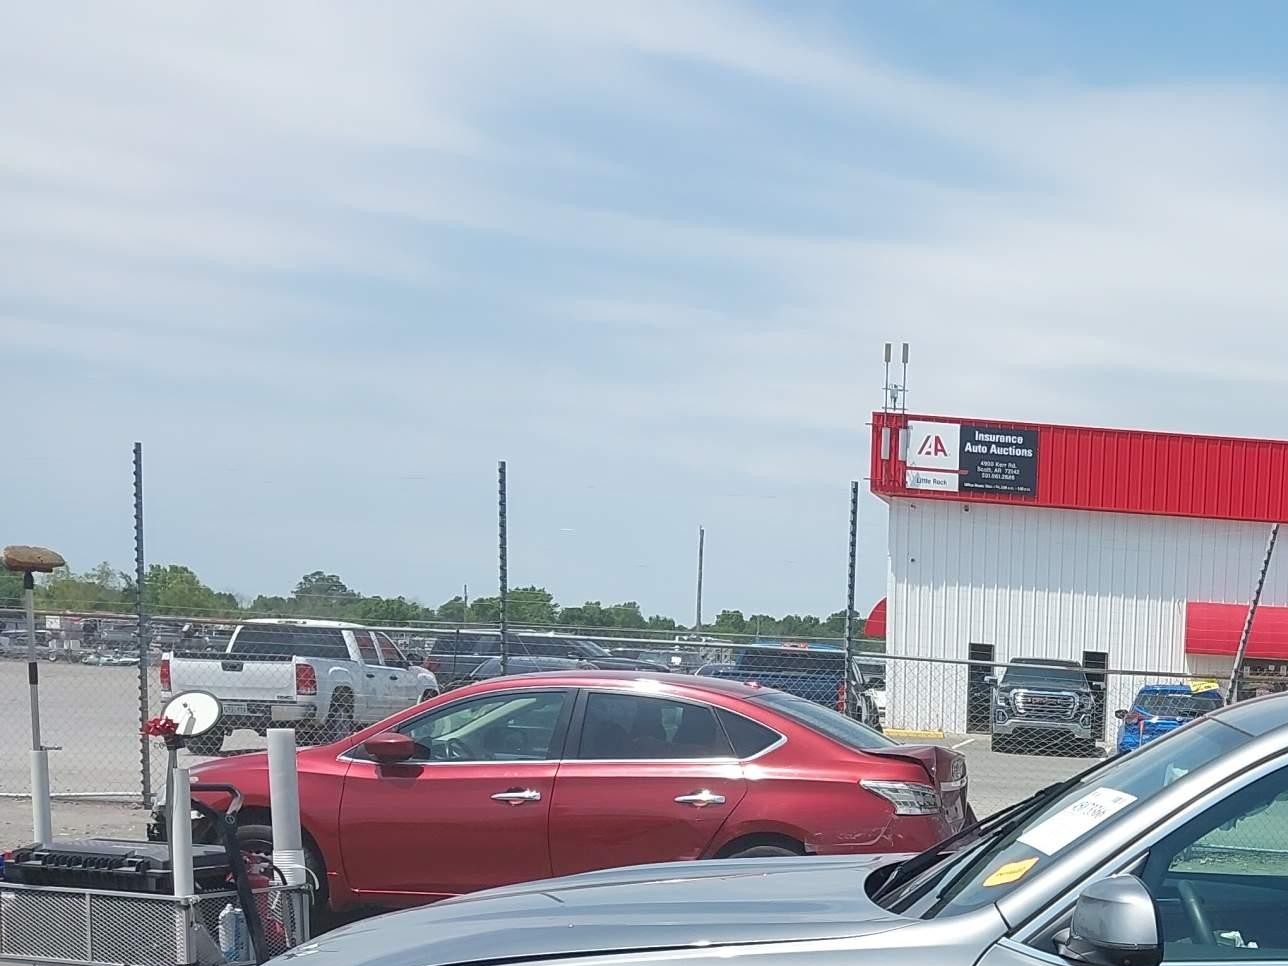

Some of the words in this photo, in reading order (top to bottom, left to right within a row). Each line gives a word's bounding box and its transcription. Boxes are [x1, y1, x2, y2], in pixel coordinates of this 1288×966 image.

[975, 430, 1024, 444] Insurance
[964, 442, 988, 454] Auto
[989, 443, 1033, 457] Auctions
